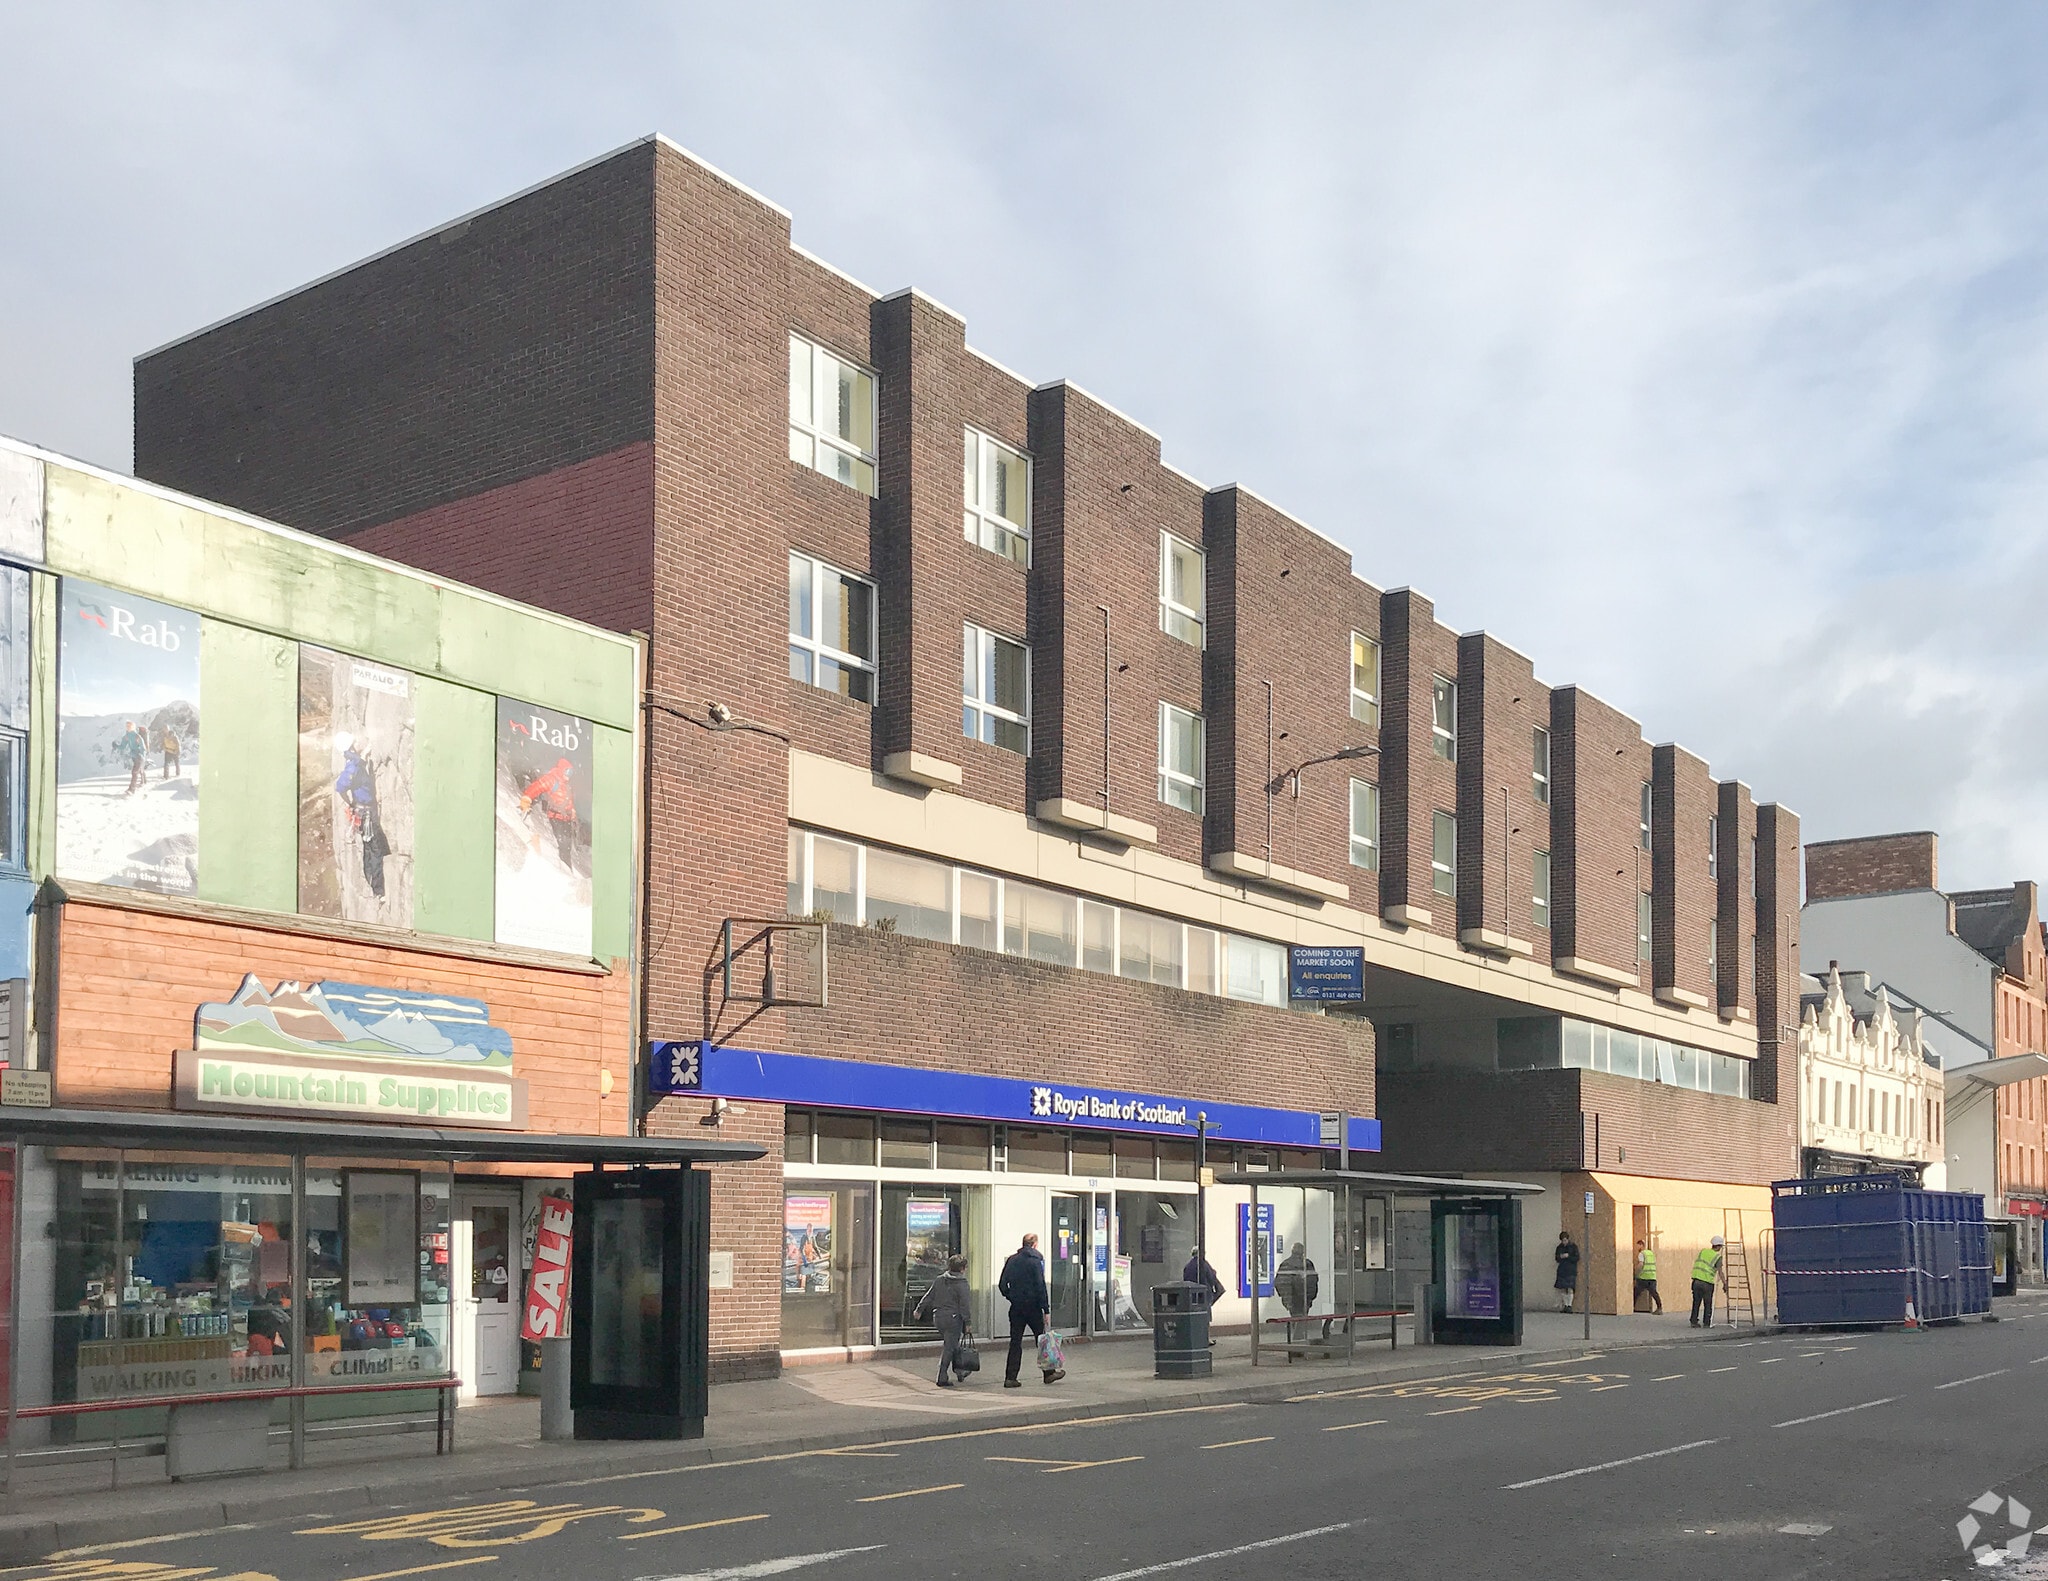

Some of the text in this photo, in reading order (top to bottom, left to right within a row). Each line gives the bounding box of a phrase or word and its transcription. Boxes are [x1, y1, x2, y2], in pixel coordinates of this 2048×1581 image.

[109, 605, 180, 652] Rab
[529, 715, 579, 751] Rab
[139, 872, 158, 882] the
[160, 876, 192, 888] world
[1294, 949, 1330, 957] COMING
[1296, 959, 1355, 967] MARKET SOON
[1302, 972, 1352, 981] All enquiries
[17, 1081, 47, 1089] stopping
[203, 1063, 508, 1116] Mountain Supplies
[1054, 1093, 1186, 1126] Royal Bank of Scotland
[1089, 1179, 1097, 1187] 131
[529, 1205, 573, 1338] SALE
[91, 1368, 197, 1394] WALKING
